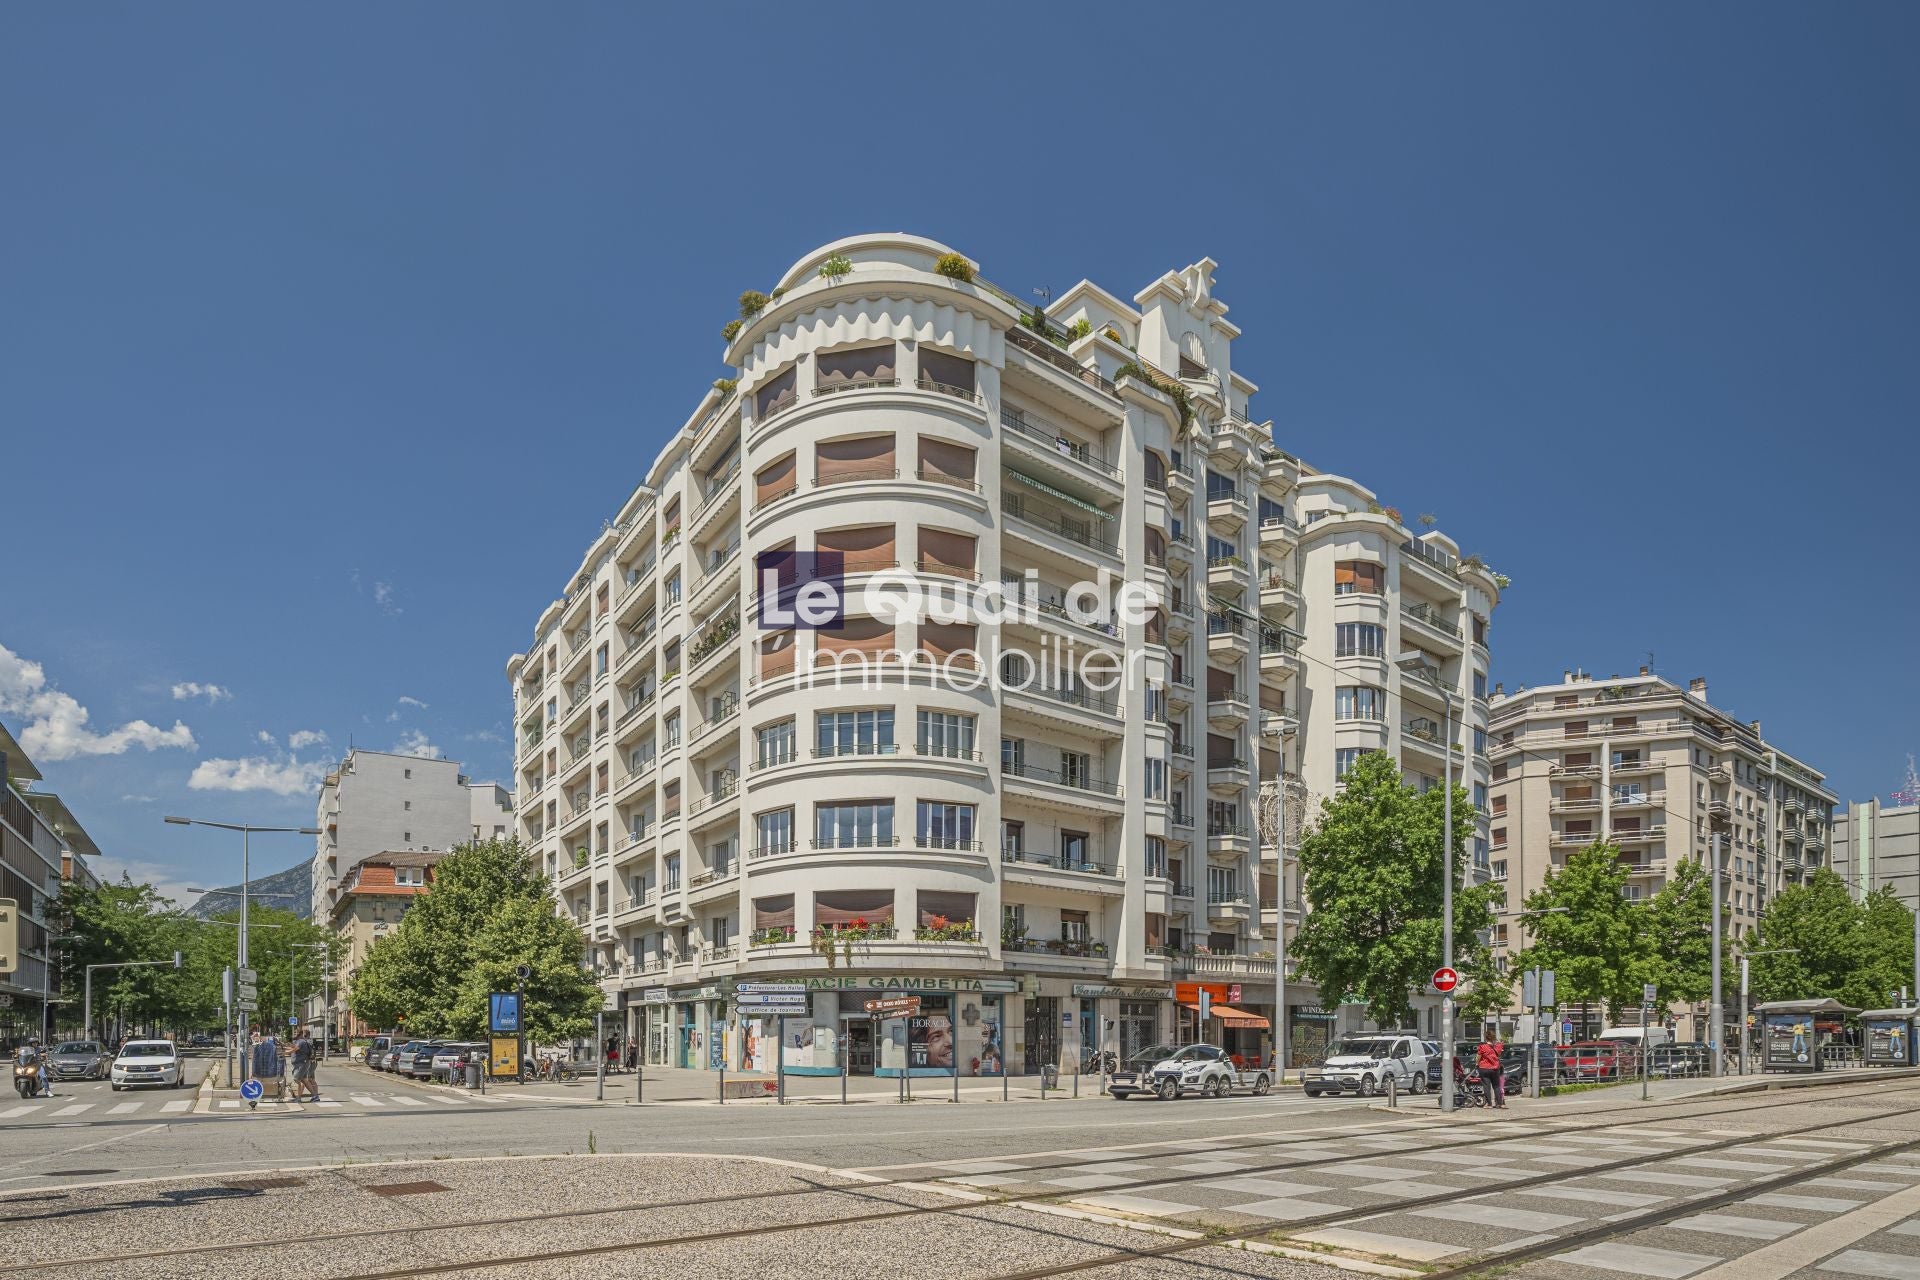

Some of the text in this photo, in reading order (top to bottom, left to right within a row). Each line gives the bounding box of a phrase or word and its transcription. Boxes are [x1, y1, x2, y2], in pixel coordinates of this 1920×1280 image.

[868, 976, 983, 991] GAMBETTA
[1075, 985, 1126, 997] Gambetta
[912, 1019, 947, 1028] HORACE
